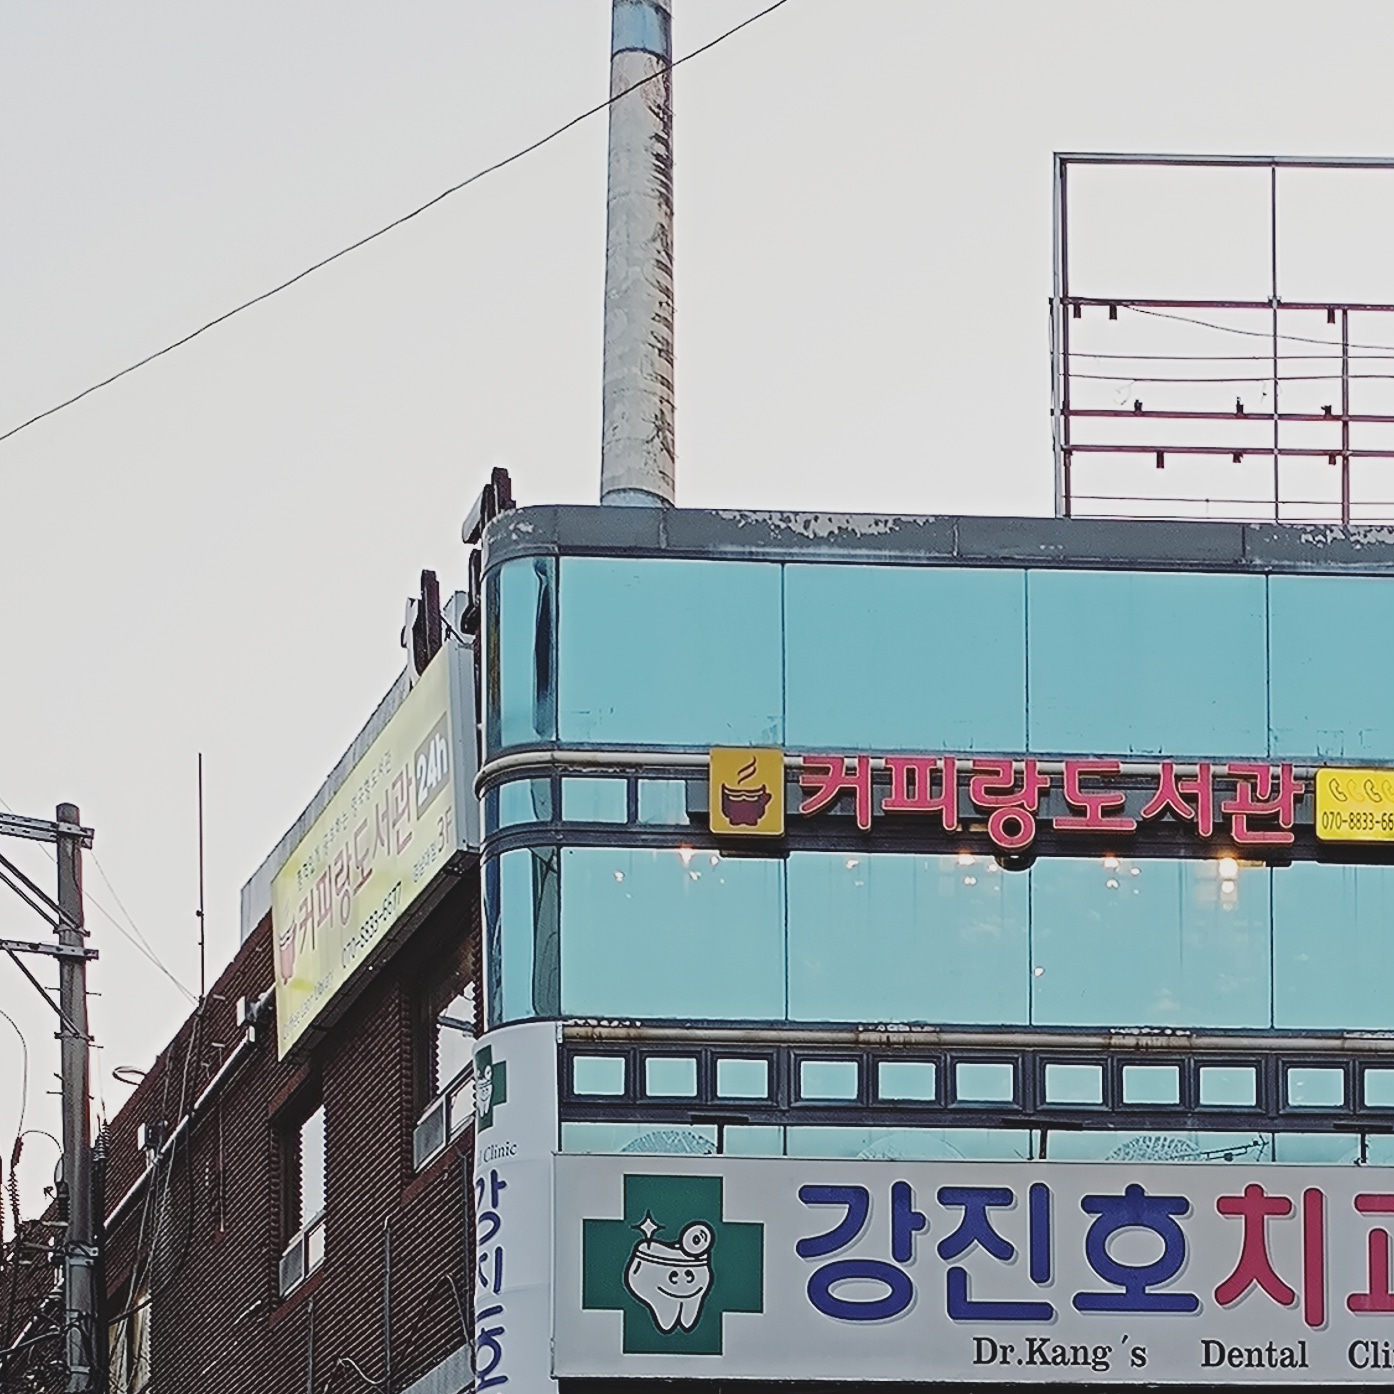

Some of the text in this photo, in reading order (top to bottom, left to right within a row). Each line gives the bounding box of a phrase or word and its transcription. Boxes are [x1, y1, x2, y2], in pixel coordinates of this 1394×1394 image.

[416, 735, 448, 806] 24h
[799, 753, 1304, 849] 커피랑도서관
[299, 763, 413, 955] 커피랑도서관
[483, 1142, 518, 1163] Clinic
[1201, 1340, 1309, 1369] Dental
